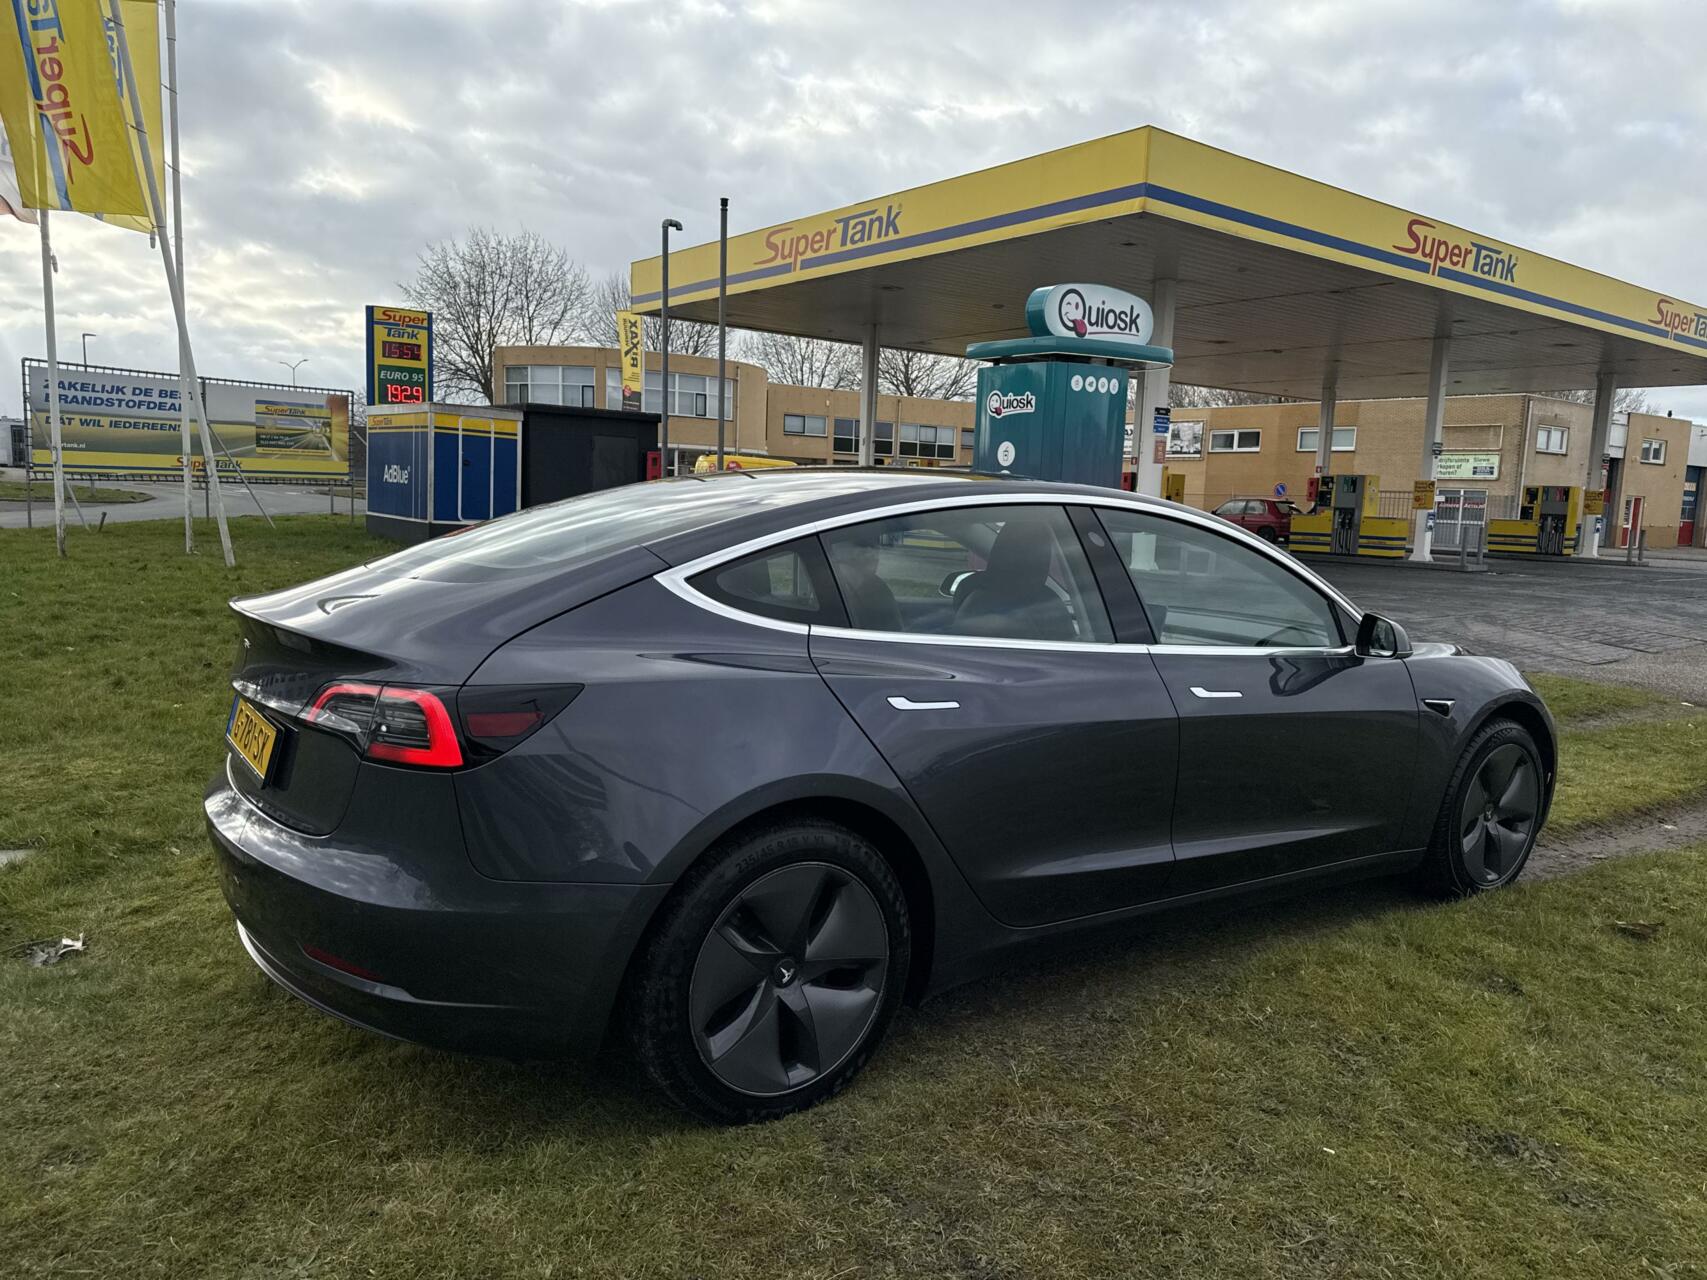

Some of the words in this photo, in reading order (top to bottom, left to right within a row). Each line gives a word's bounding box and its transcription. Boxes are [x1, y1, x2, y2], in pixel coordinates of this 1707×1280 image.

[753, 204, 902, 272] SuperTank
[1392, 218, 1517, 284] SuperTank
[375, 309, 427, 327] Super
[1058, 288, 1141, 338] Quiosk
[383, 326, 419, 340] Tank
[380, 370, 409, 380] EURO
[411, 373, 424, 383] 95
[131, 386, 155, 398] DE
[988, 392, 1034, 416] Quiosk
[79, 418, 105, 428] WIL
[109, 420, 181, 432] IEDEREEN!
[383, 464, 409, 485] AdBlue
